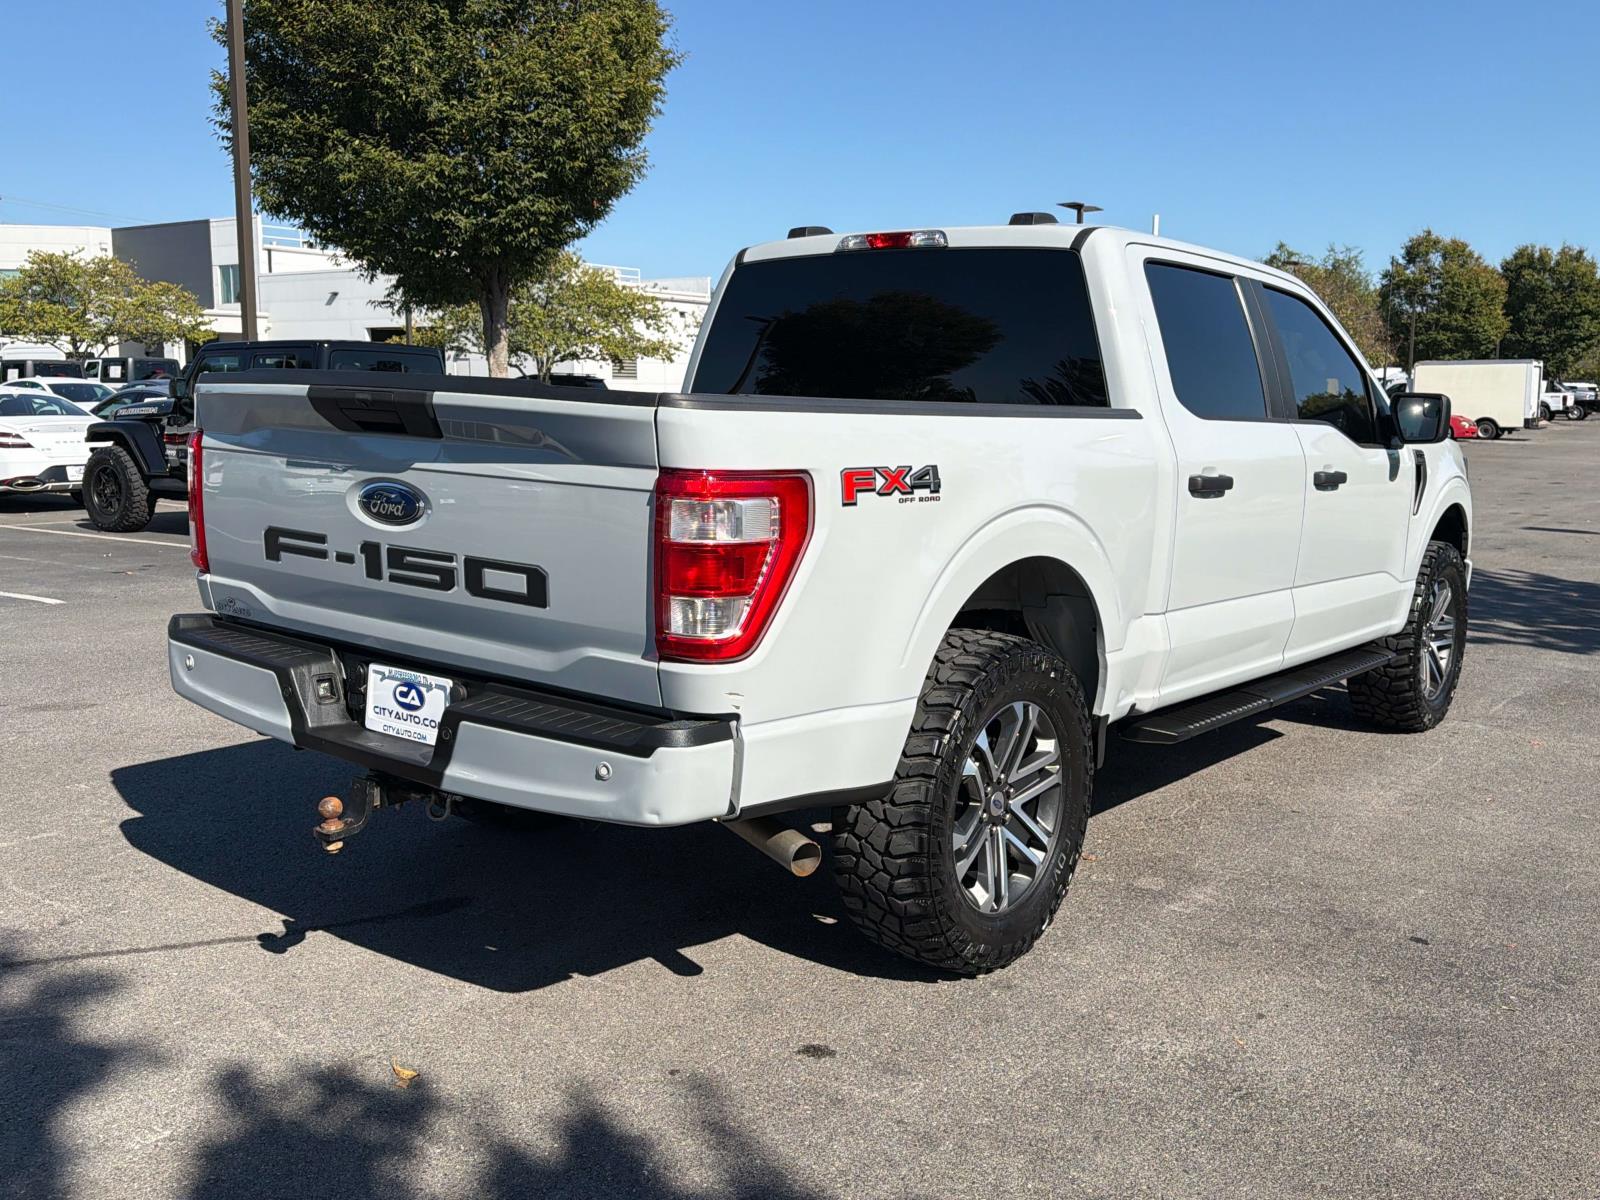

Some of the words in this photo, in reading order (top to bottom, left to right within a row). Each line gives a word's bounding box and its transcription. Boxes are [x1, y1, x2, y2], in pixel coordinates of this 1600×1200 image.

[840, 464, 941, 507] FX4
[370, 490, 405, 516] Ford
[918, 495, 941, 503] ROAD
[264, 526, 549, 609] F-150
[395, 686, 422, 706] CA
[373, 705, 440, 730] CITYAUTO.CO
